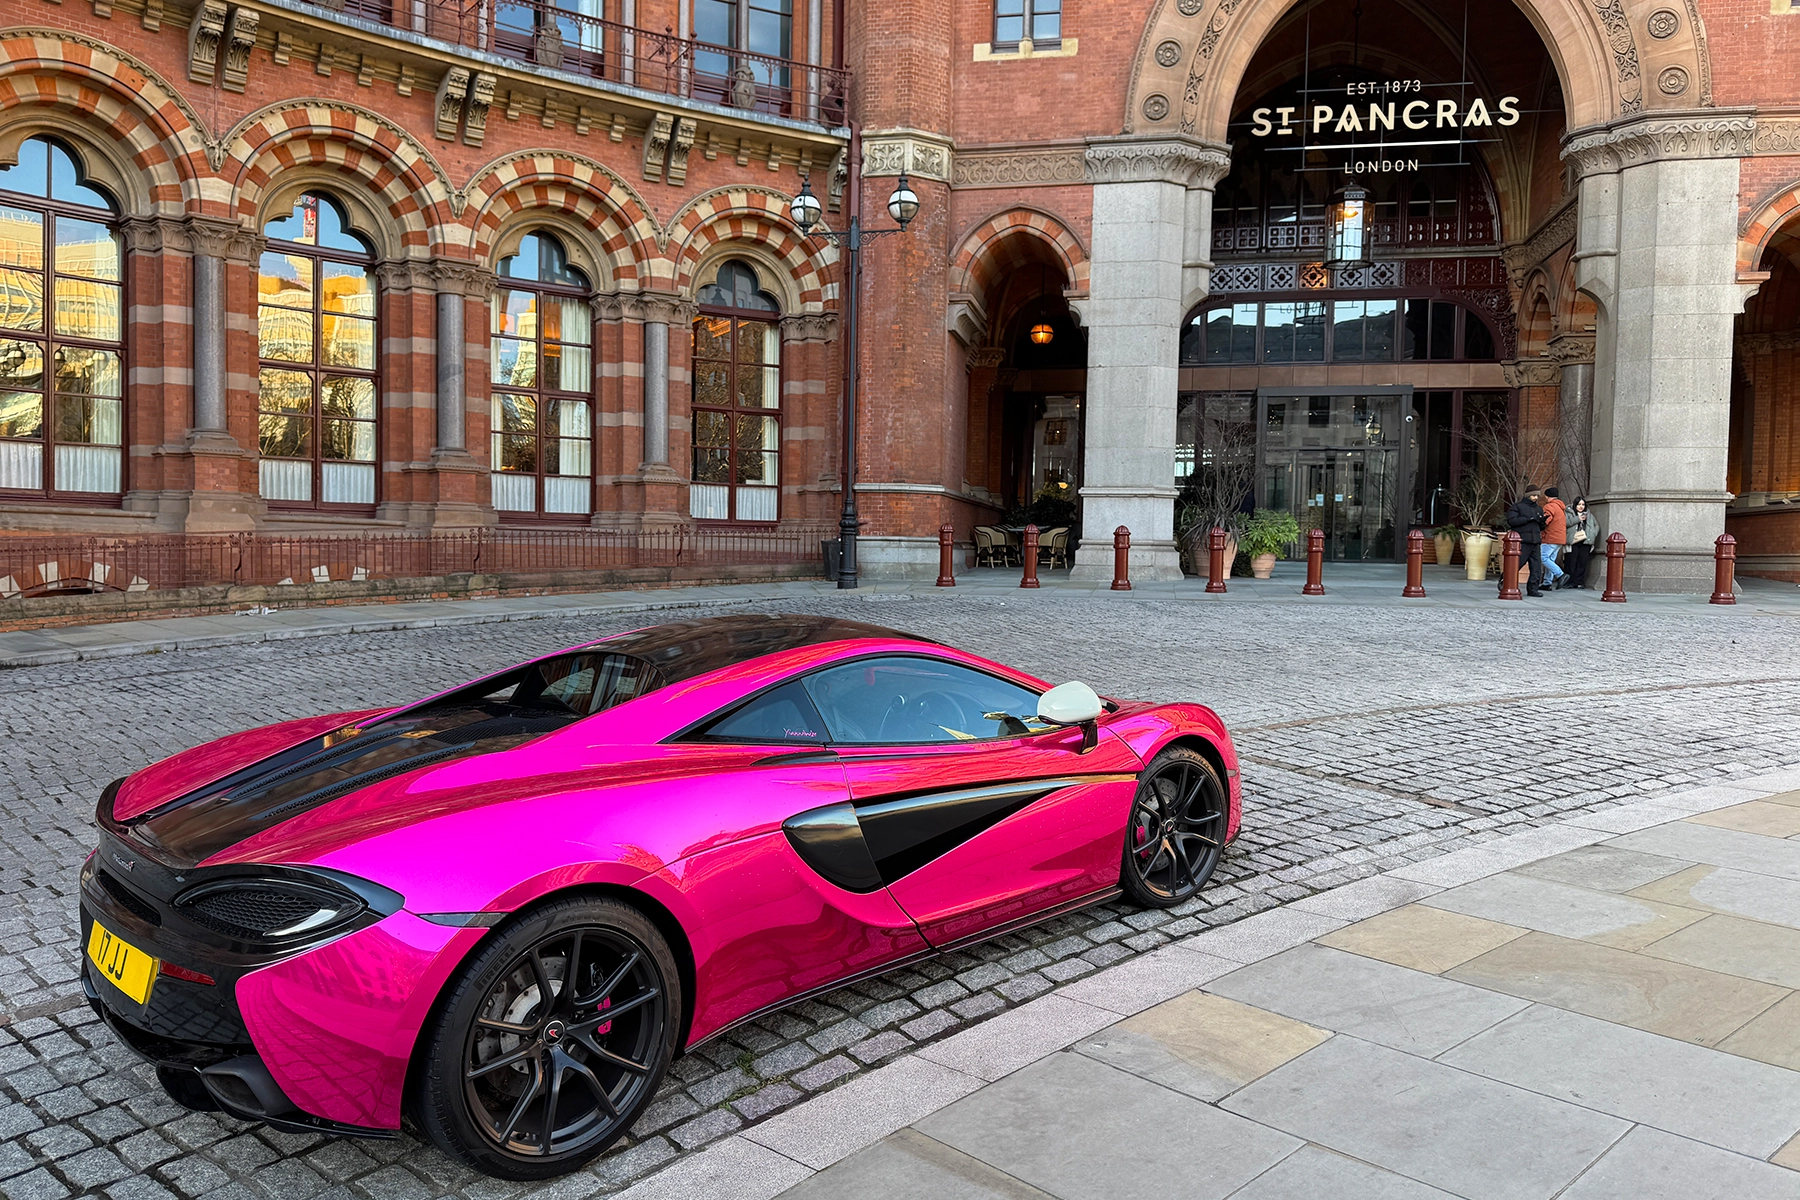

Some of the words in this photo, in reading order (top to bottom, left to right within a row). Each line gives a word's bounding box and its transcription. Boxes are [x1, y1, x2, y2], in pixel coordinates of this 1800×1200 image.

[1313, 96, 1520, 133] PANCRAS
[1344, 159, 1419, 174] LONDON
[97, 930, 111, 964] 17
[108, 943, 128, 980] JJ
[472, 943, 516, 991] PIRELLI
